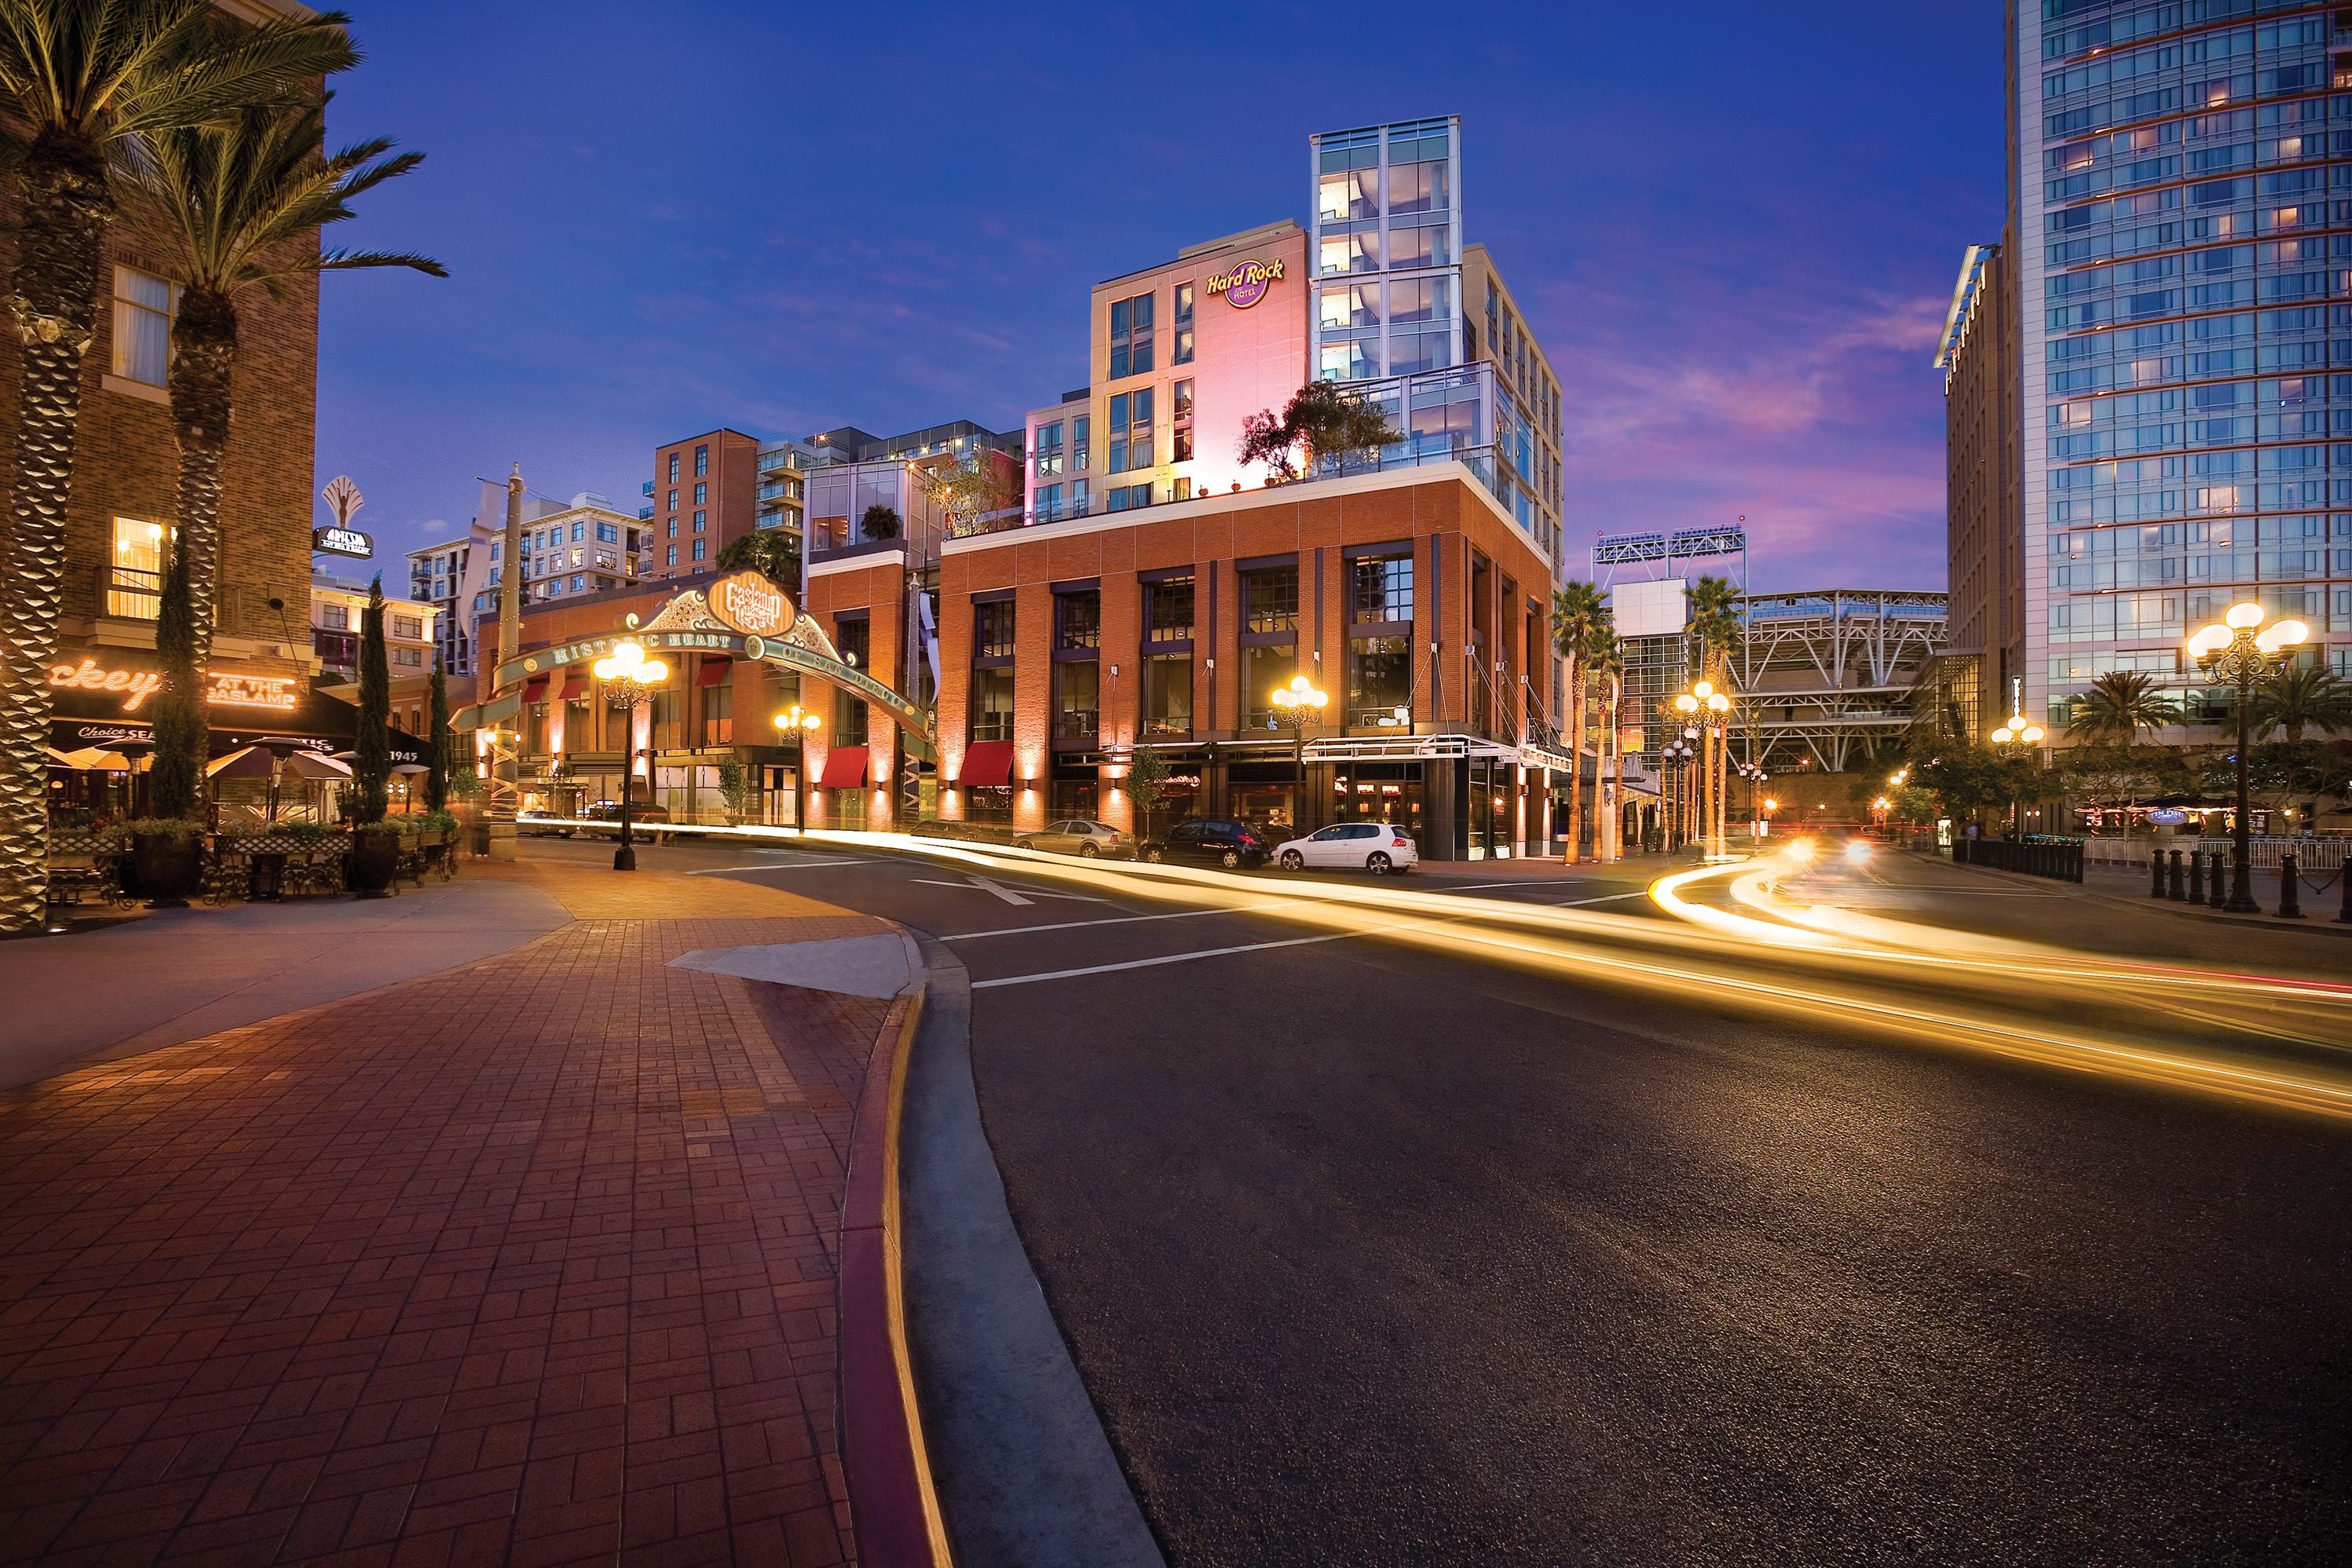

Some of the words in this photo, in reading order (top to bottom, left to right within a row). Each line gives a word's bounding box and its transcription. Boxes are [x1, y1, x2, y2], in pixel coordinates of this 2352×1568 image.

[1206, 269, 1245, 294] Hard
[1246, 258, 1284, 285] Rock
[1234, 288, 1256, 299] HOTEL
[726, 582, 781, 619] Gaslamp
[668, 633, 731, 649] HEART
[781, 646, 803, 660] OF
[812, 656, 843, 676] SAN
[854, 673, 900, 707] DIEGO
[216, 678, 240, 689] AT
[247, 680, 283, 693] THE
[79, 726, 127, 737] Choice
[389, 751, 418, 762] 1945
